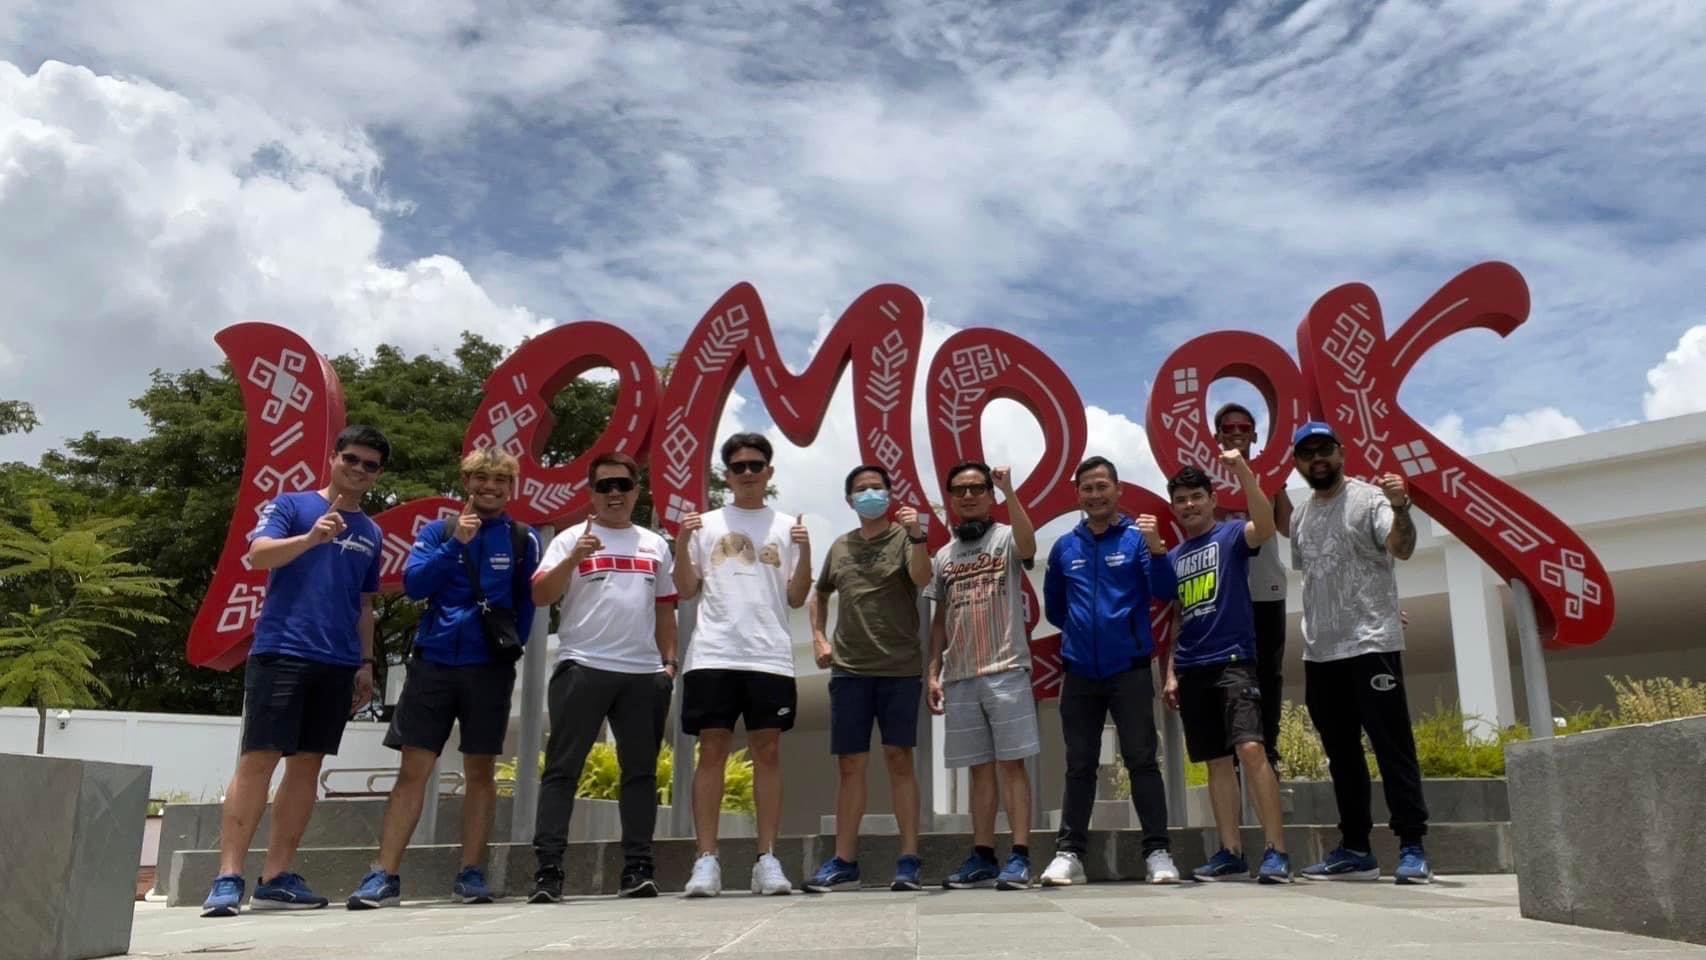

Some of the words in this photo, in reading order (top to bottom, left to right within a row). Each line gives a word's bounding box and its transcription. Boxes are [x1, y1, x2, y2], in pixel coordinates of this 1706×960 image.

[188, 260, 1613, 698] LOMBOK
[1176, 546, 1216, 577] MASTER
[1178, 571, 1215, 608] CAMP
